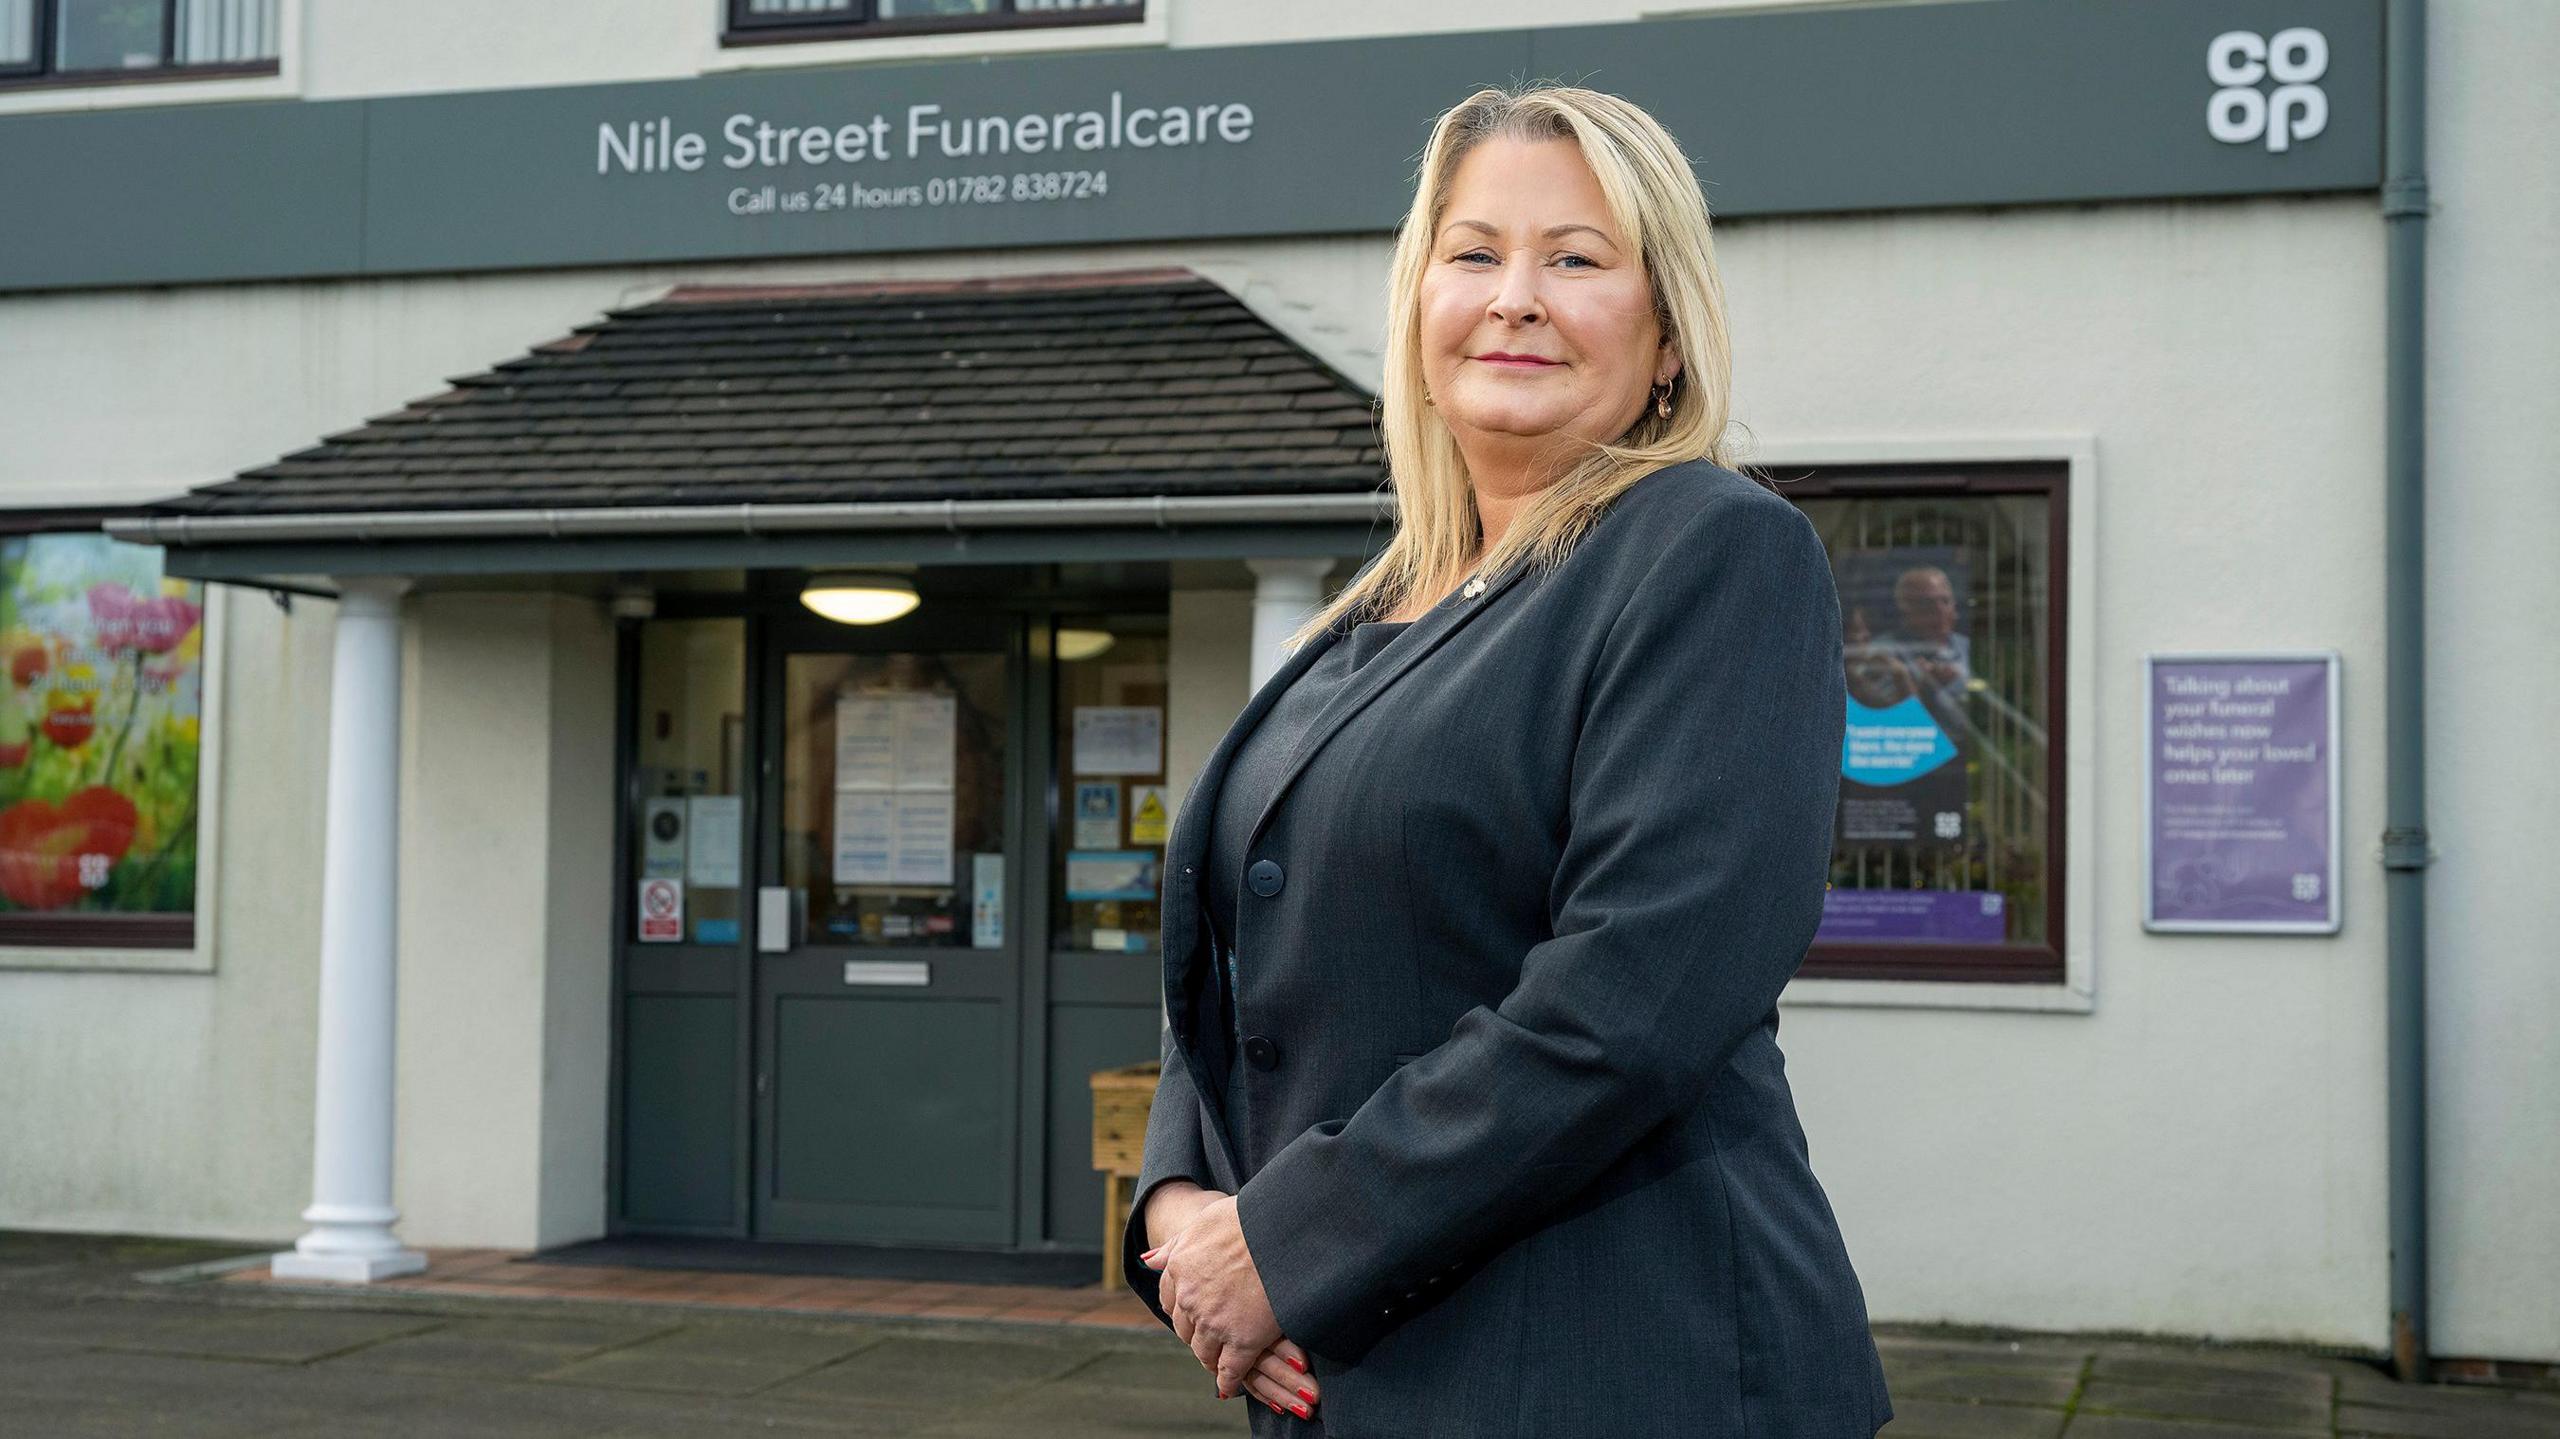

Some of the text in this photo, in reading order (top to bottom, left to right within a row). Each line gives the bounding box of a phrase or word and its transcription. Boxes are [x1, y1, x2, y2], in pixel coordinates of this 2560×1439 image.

[597, 90, 1254, 174] Nile Street Funeralcare
[728, 169, 1108, 215] Call us 24 hours 01782 838724
[2164, 676, 2289, 698] Talking about
[2164, 699, 2275, 721] your funeral
[2164, 721, 2272, 739] wishes now
[2163, 742, 2316, 765] helps your loved
[2163, 766, 2255, 785] ones later
